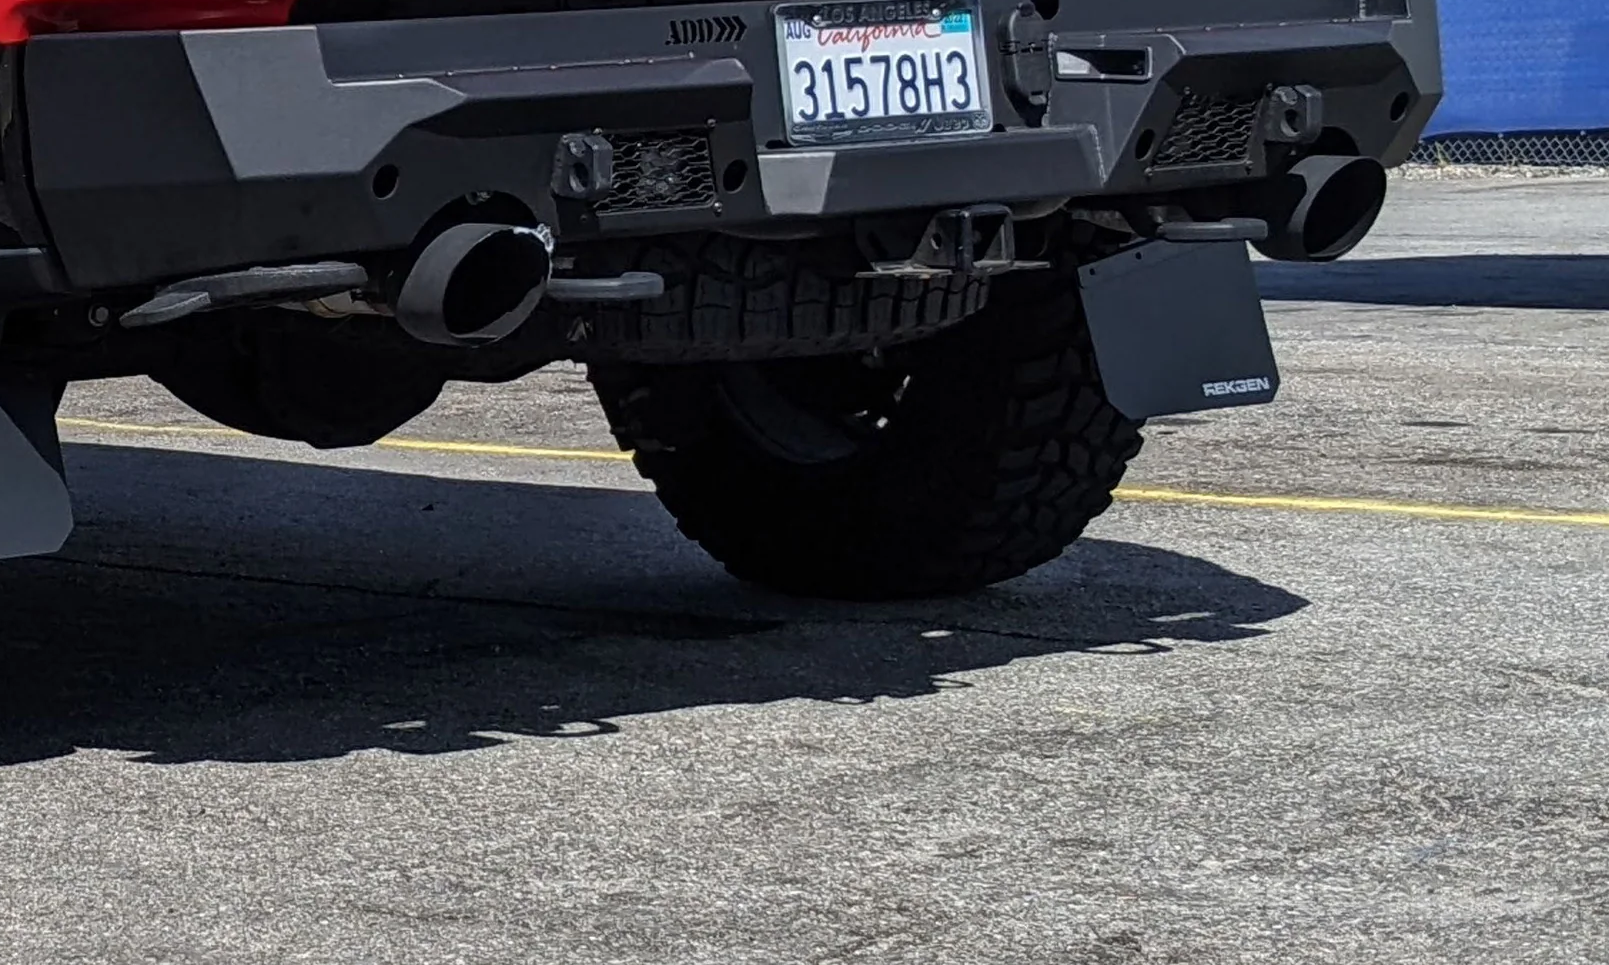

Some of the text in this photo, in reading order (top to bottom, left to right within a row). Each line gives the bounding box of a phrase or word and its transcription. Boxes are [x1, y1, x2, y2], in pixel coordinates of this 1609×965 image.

[785, 20, 811, 40] AUG
[817, 18, 942, 53] California
[794, 50, 971, 123] 31578H3
